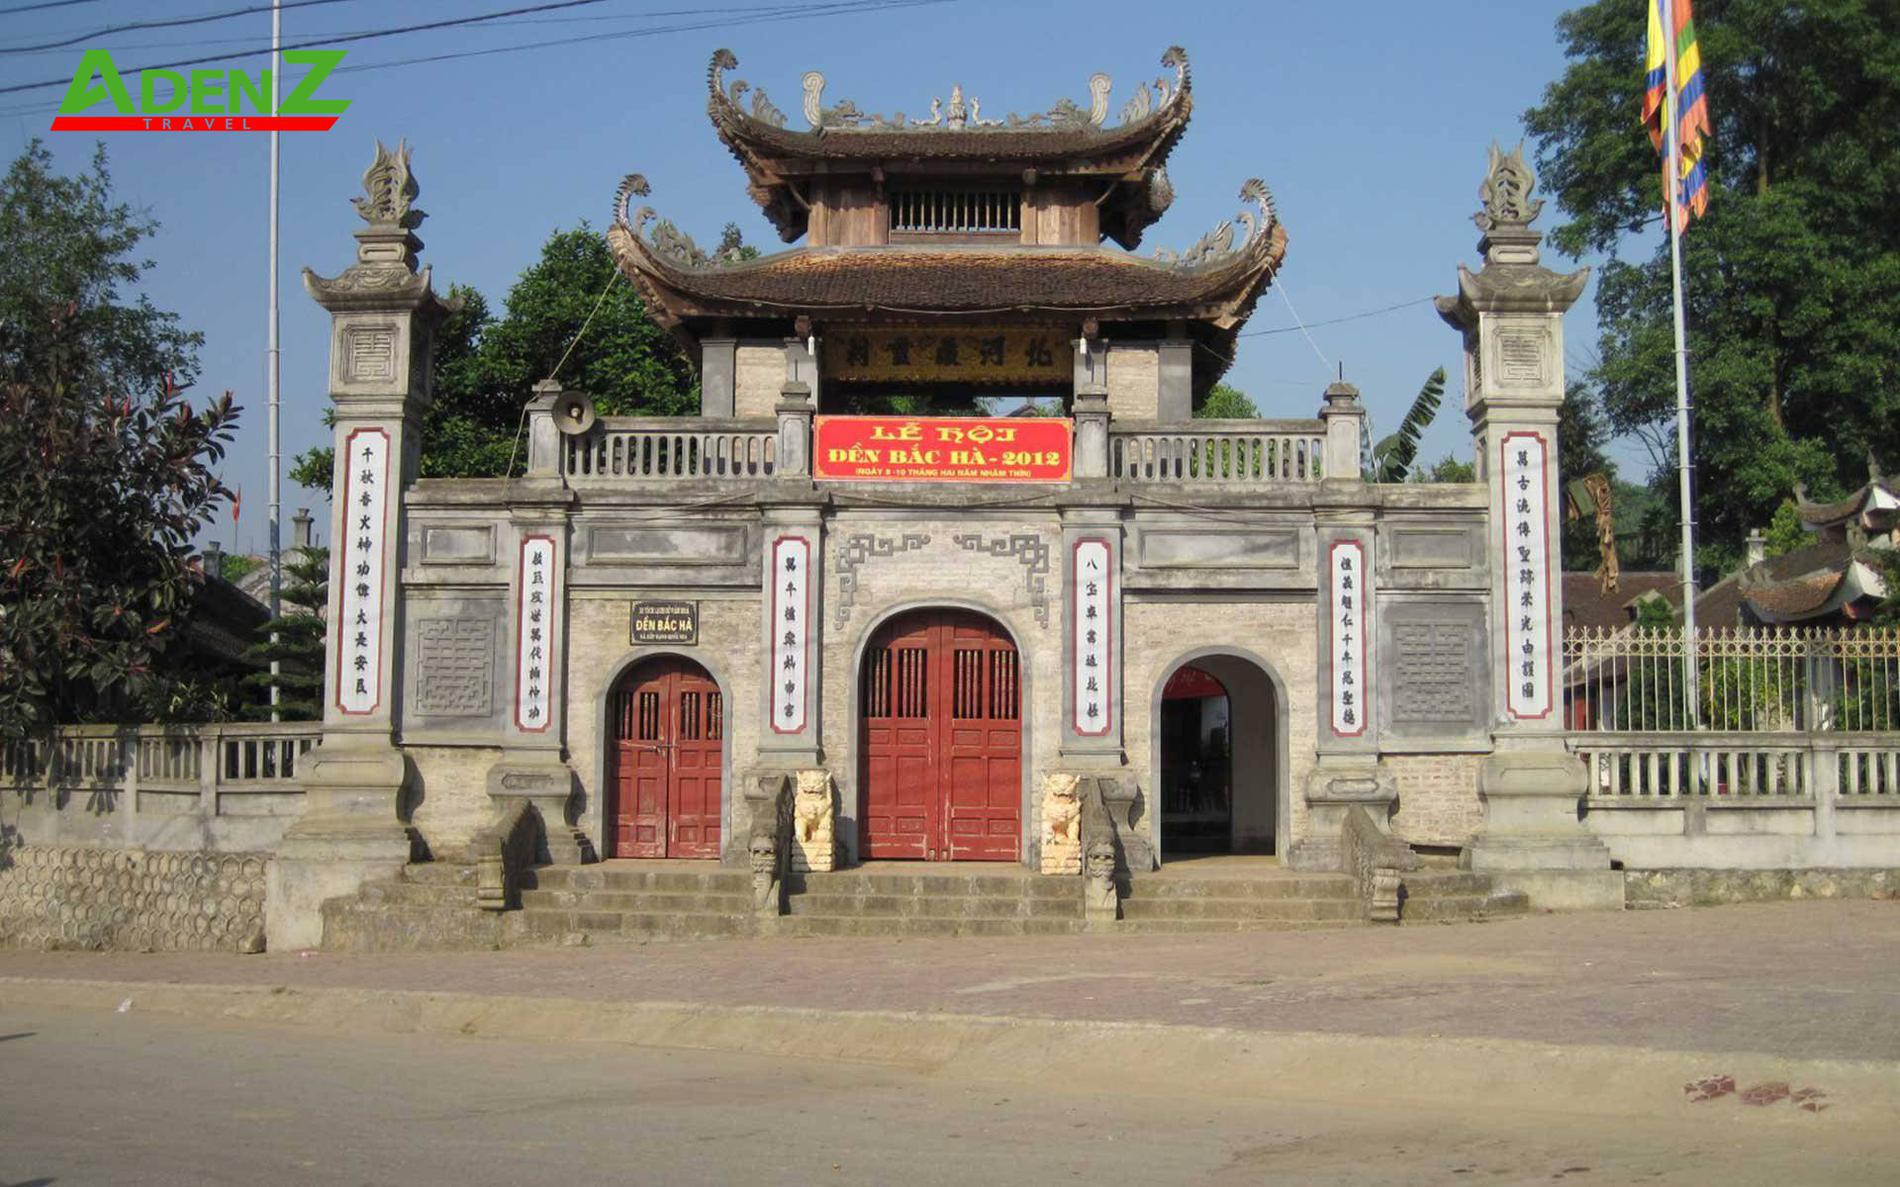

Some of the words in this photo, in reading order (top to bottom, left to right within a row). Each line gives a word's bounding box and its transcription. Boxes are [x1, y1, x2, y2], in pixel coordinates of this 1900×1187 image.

[870, 422, 923, 441] LỄ
[936, 425, 1018, 444] HỘI
[828, 441, 881, 463] ĐỀN
[888, 443, 941, 465] BẮC
